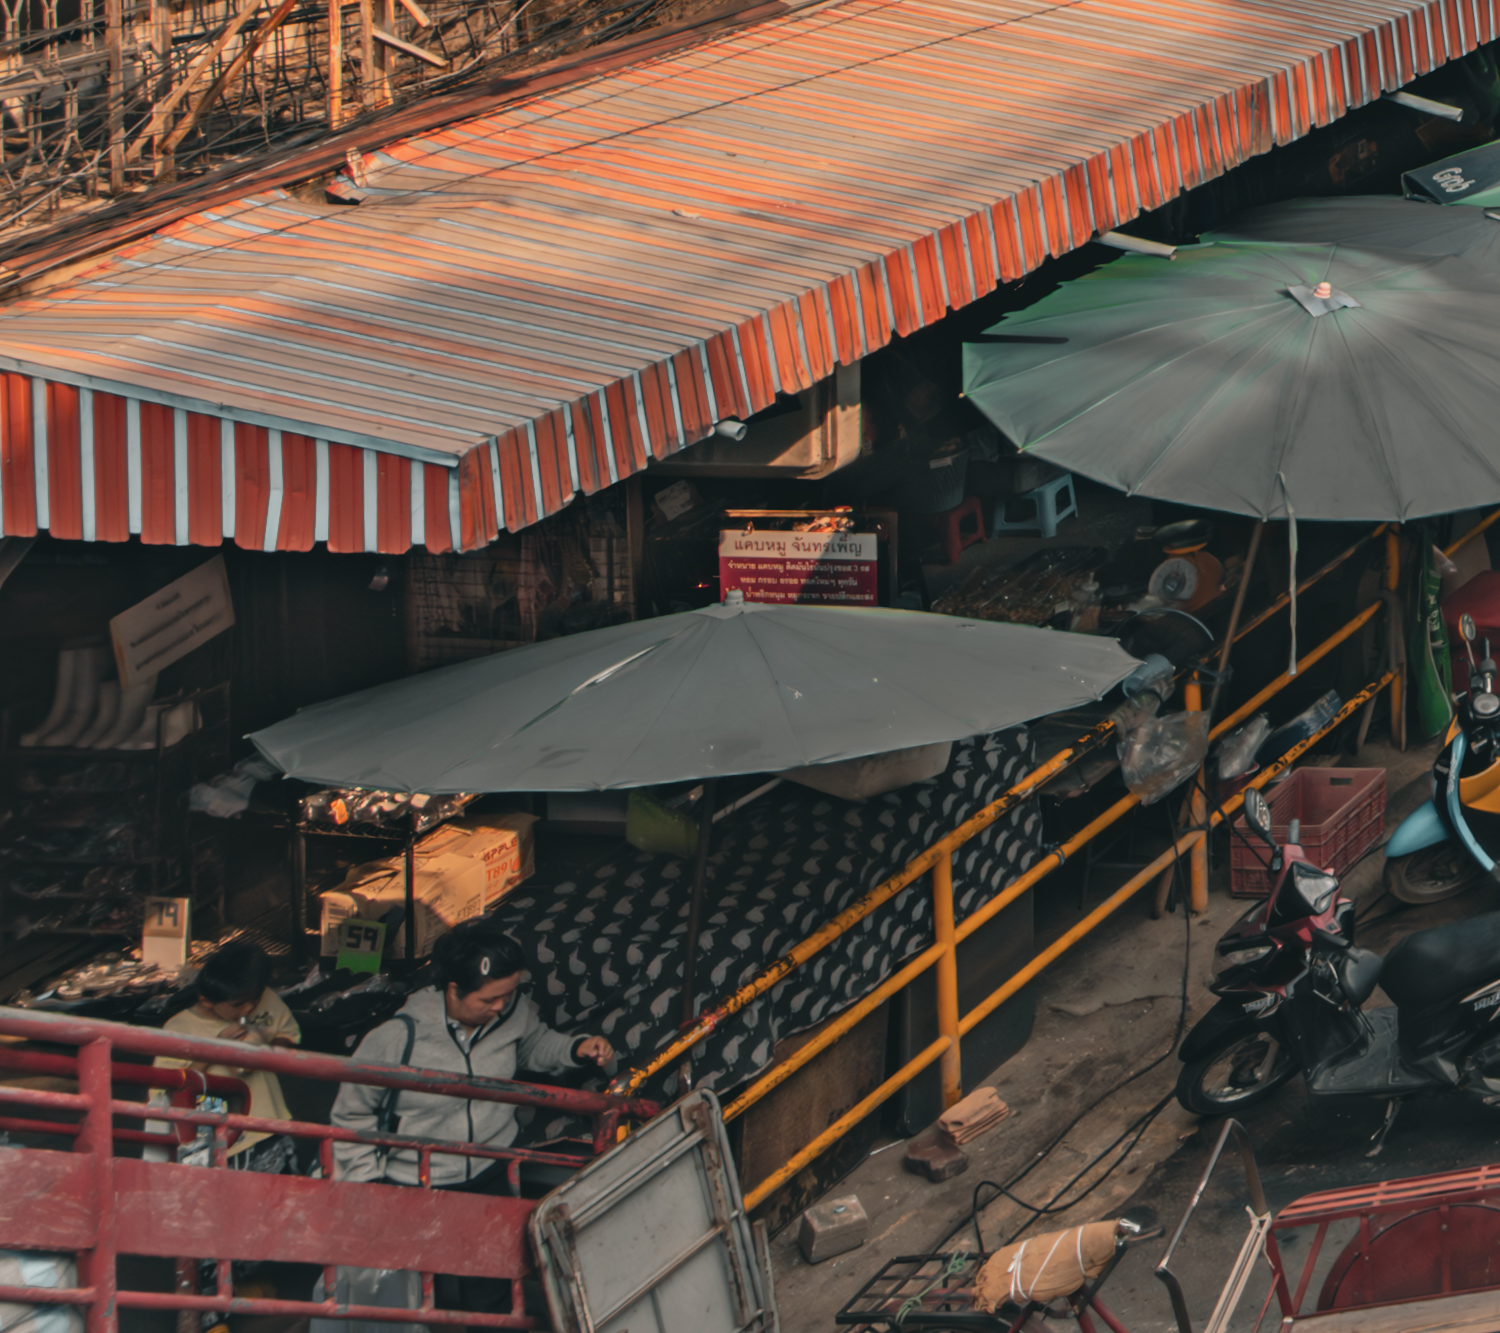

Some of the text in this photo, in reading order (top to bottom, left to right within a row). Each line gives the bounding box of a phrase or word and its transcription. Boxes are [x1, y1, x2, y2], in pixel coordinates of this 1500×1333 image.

[1432, 167, 1476, 193] Grab
[735, 533, 863, 557] แคบหมู จันทร์เพ็ญ
[758, 562, 785, 573] แคบหมู
[484, 836, 518, 863] APPLE
[346, 925, 379, 952] 59
